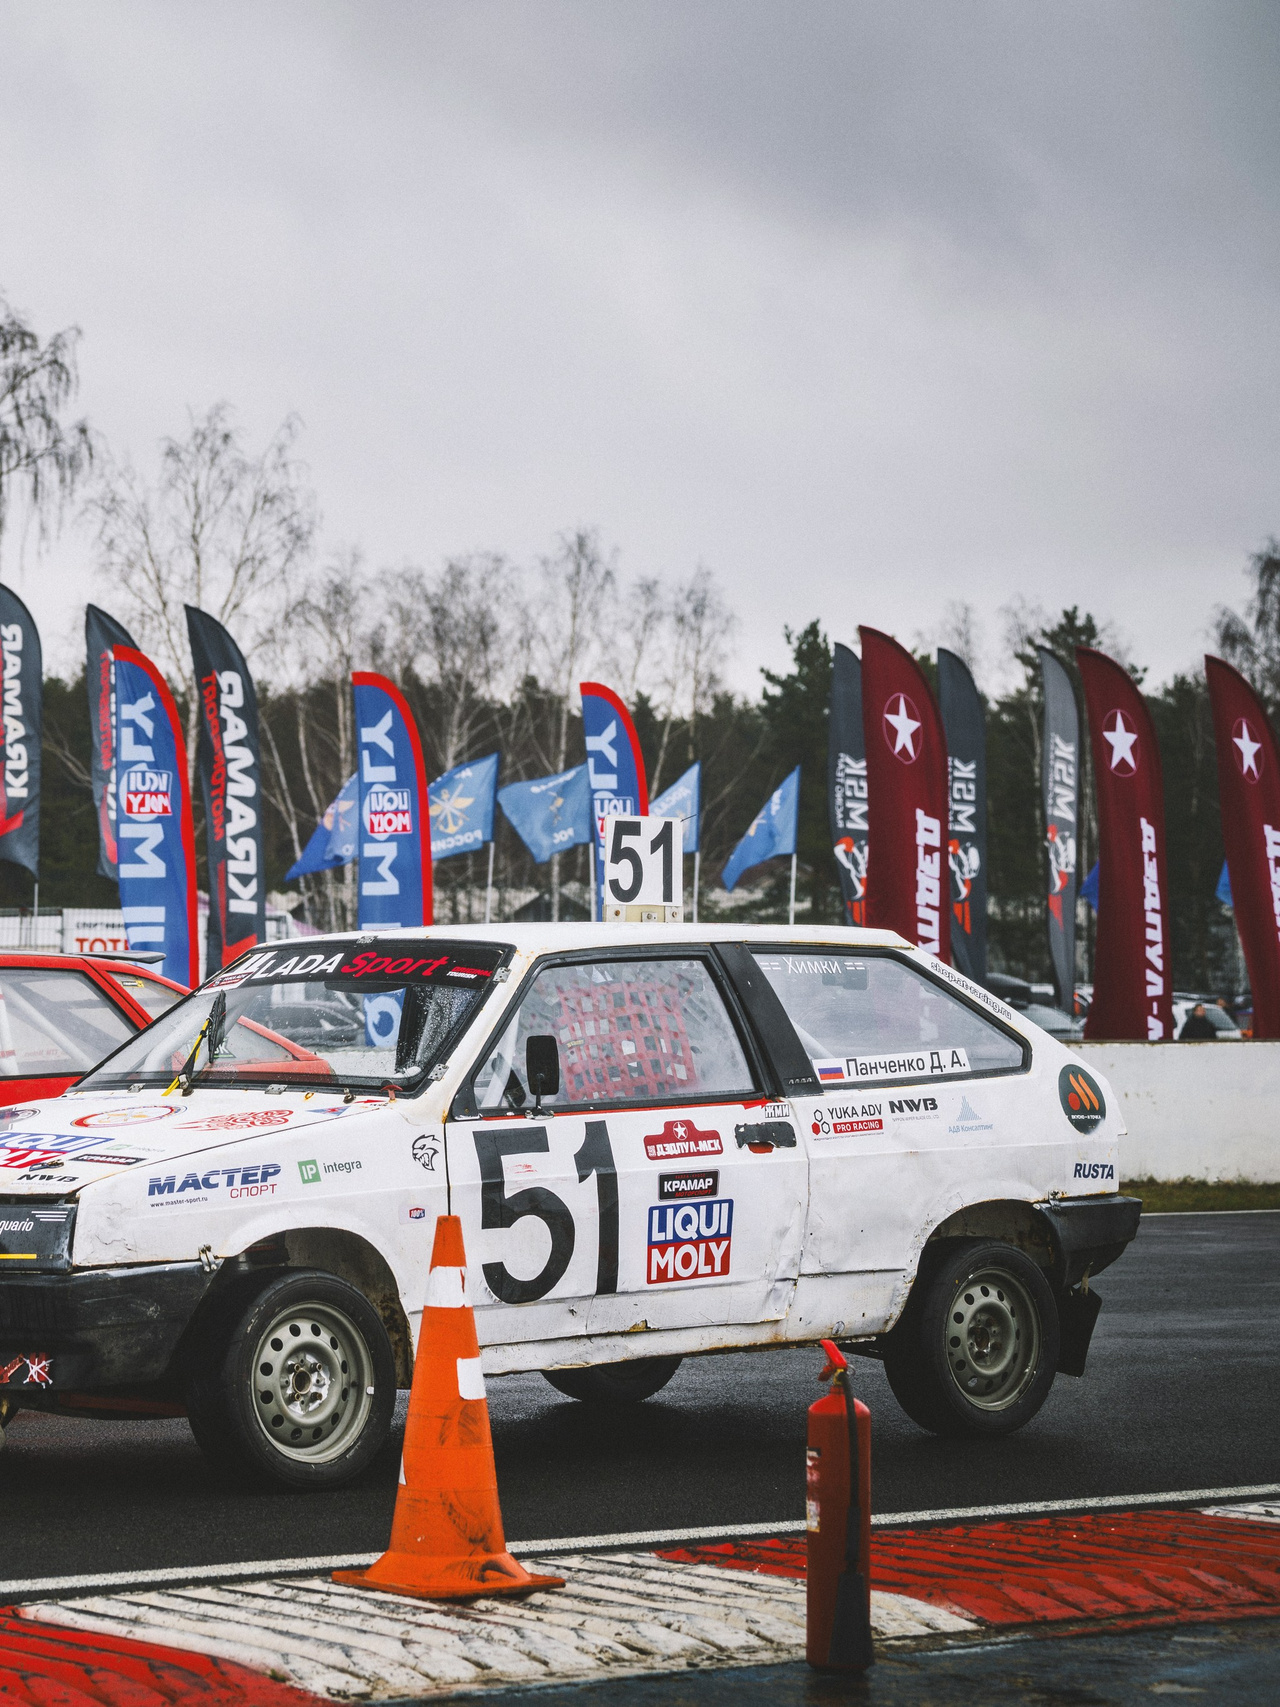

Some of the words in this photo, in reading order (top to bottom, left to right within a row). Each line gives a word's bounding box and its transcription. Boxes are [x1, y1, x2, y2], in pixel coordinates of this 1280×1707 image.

[609, 820, 673, 903] 51
[254, 952, 344, 979] LADA
[341, 951, 449, 978] Sport
[782, 956, 842, 975] Химки
[845, 1056, 926, 1077] Панченко
[930, 1051, 946, 1074] Д.
[951, 1049, 966, 1068] А.
[764, 1104, 790, 1119] ЖМИ
[827, 1106, 859, 1120] YUKA
[861, 1104, 882, 1117] ADV
[888, 1097, 939, 1114] NWB
[836, 1122, 853, 1132] PRO
[853, 1120, 880, 1132] RACING
[961, 1123, 993, 1133] Консалтинг
[323, 1159, 362, 1174] integra
[1073, 1162, 1114, 1180] RUSTA
[17, 1174, 80, 1183] NWB
[147, 1163, 282, 1197] МАСТЕР
[664, 1178, 714, 1193] КРАМАР
[229, 1183, 279, 1199] СПОРТ
[149, 1196, 208, 1208] www.master-sport.ru
[472, 1119, 620, 1304] 51
[652, 1203, 730, 1242] LIQUI
[650, 1241, 731, 1281] MOLY
